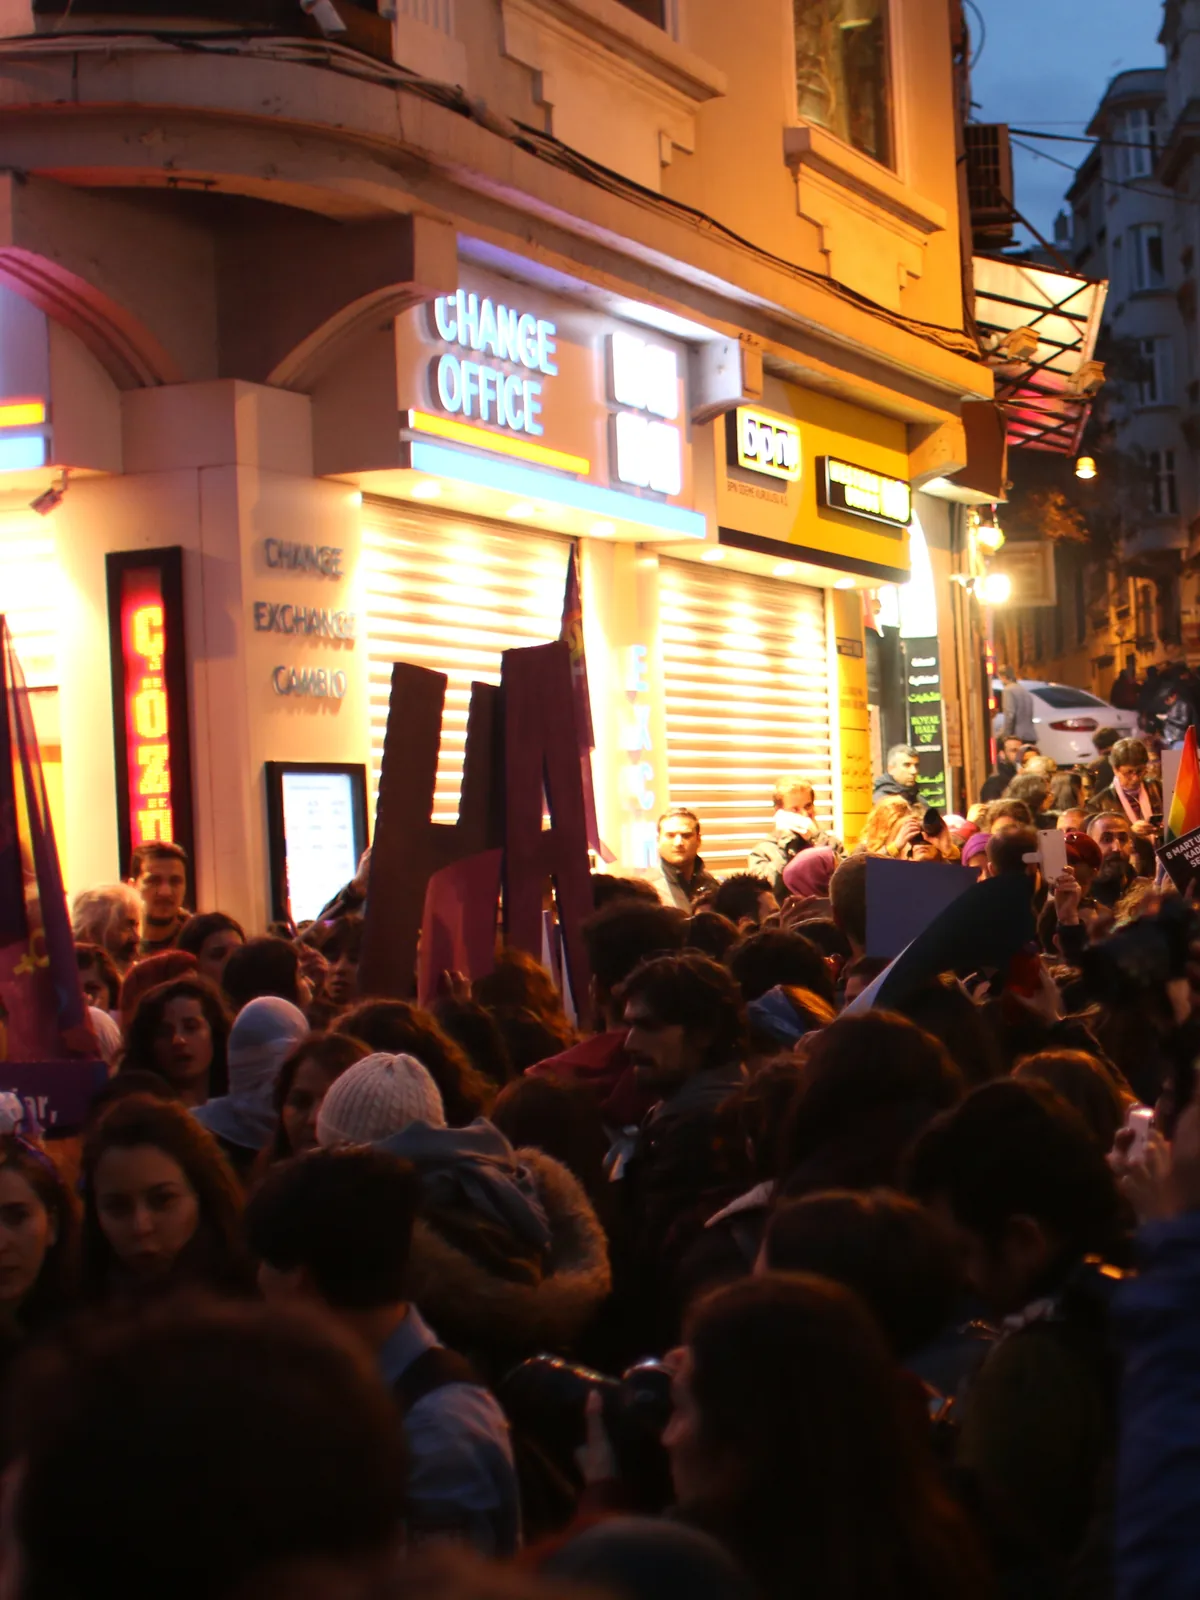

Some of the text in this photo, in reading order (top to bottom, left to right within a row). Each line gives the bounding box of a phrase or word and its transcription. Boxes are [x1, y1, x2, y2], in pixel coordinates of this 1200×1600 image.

[435, 289, 558, 376] CHANGE
[438, 354, 543, 436] OFFICE
[264, 538, 343, 576] CHANGE
[253, 601, 356, 640] EXCHANGE
[272, 665, 347, 698] CAMBIO
[1165, 852, 1173, 860] 8
[1172, 838, 1196, 858] MART
